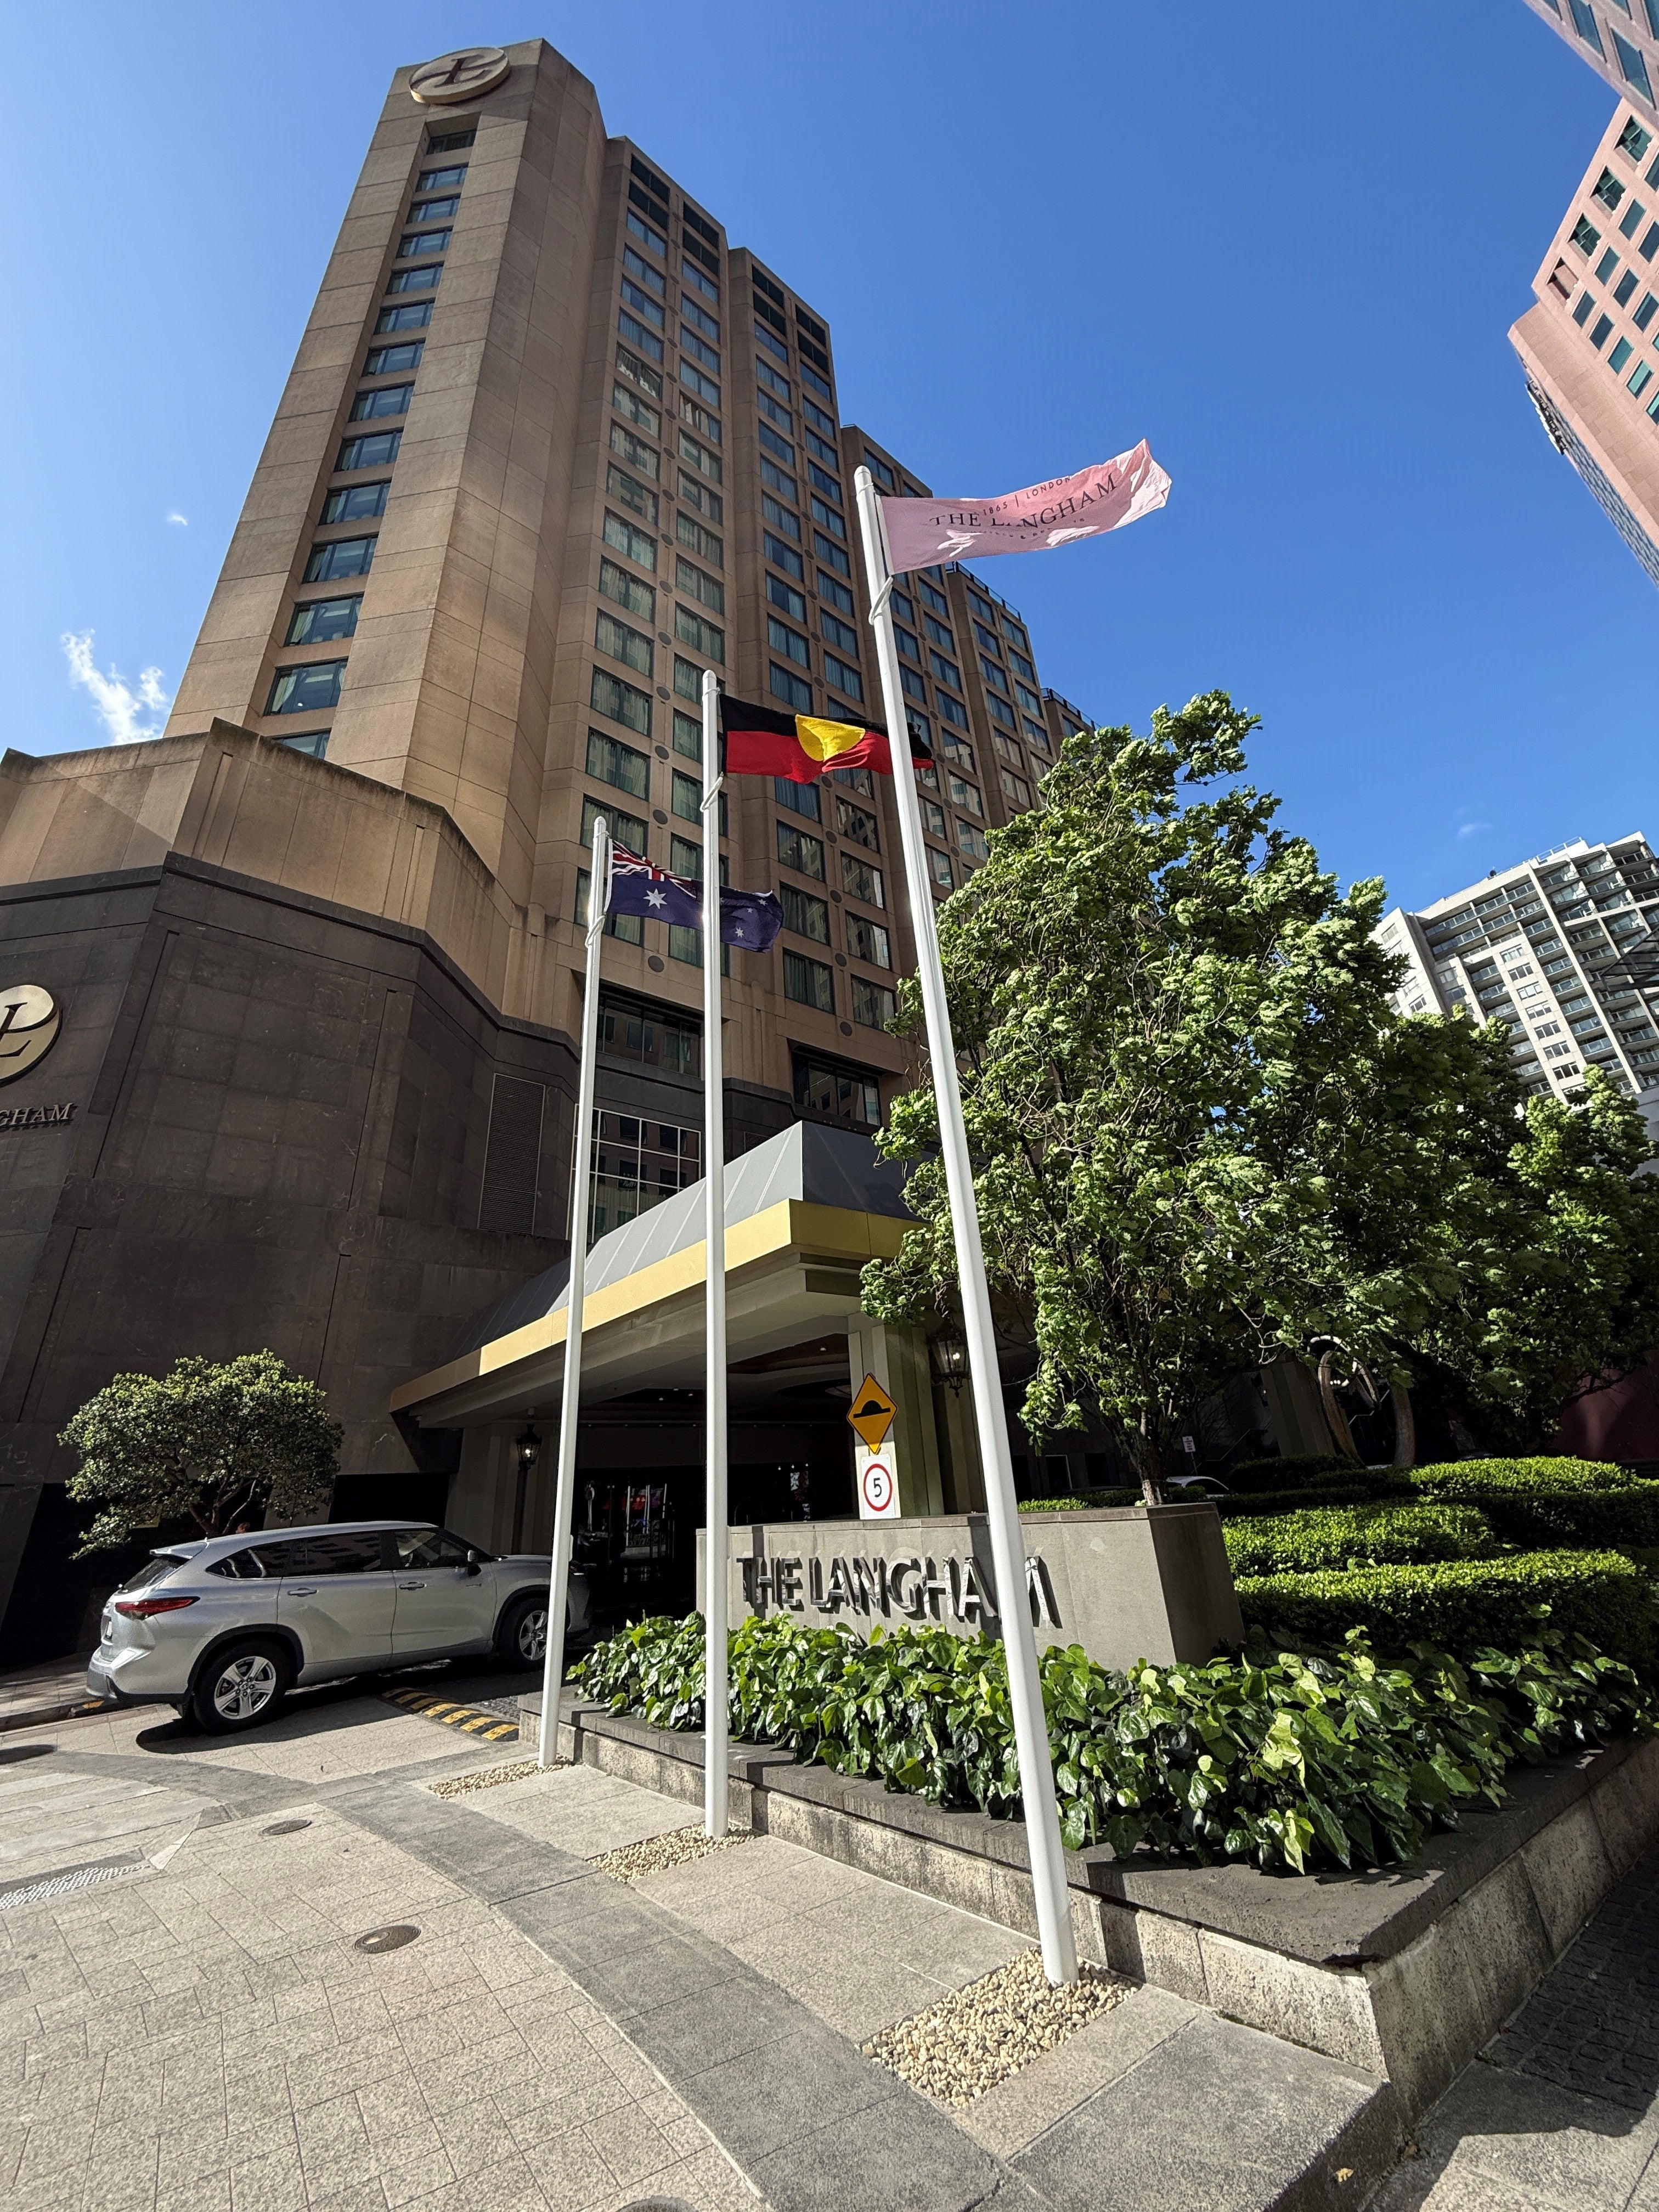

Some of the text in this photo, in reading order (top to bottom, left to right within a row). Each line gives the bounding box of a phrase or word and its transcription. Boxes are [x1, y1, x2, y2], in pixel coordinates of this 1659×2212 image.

[929, 513, 981, 527] THE
[991, 472, 1117, 529] LNGHAM
[983, 501, 1008, 516] 1865
[1026, 477, 1071, 499] LONDON
[873, 1477, 882, 1498] 5
[736, 1556, 803, 1607] THE
